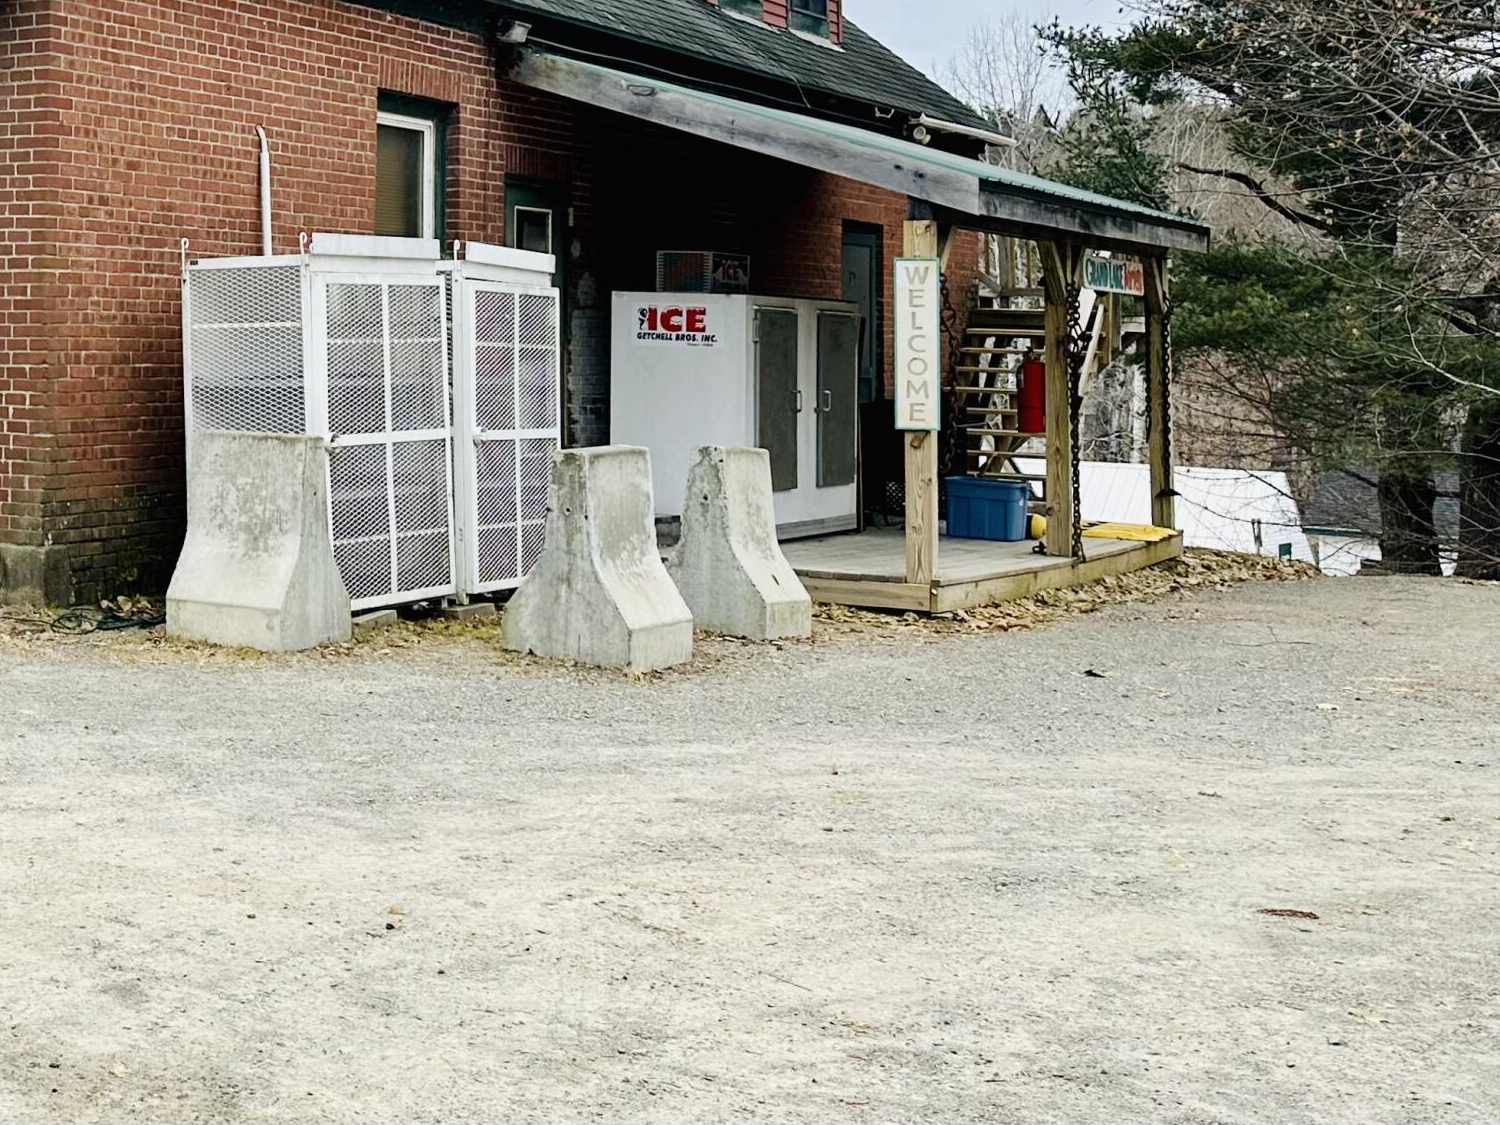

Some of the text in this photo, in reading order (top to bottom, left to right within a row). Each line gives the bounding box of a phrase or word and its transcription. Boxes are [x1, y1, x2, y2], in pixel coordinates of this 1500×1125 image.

[647, 304, 706, 332] ICE
[637, 332, 718, 343] GETCHELL BROS. INC.
[904, 266, 930, 422] WELCOME
